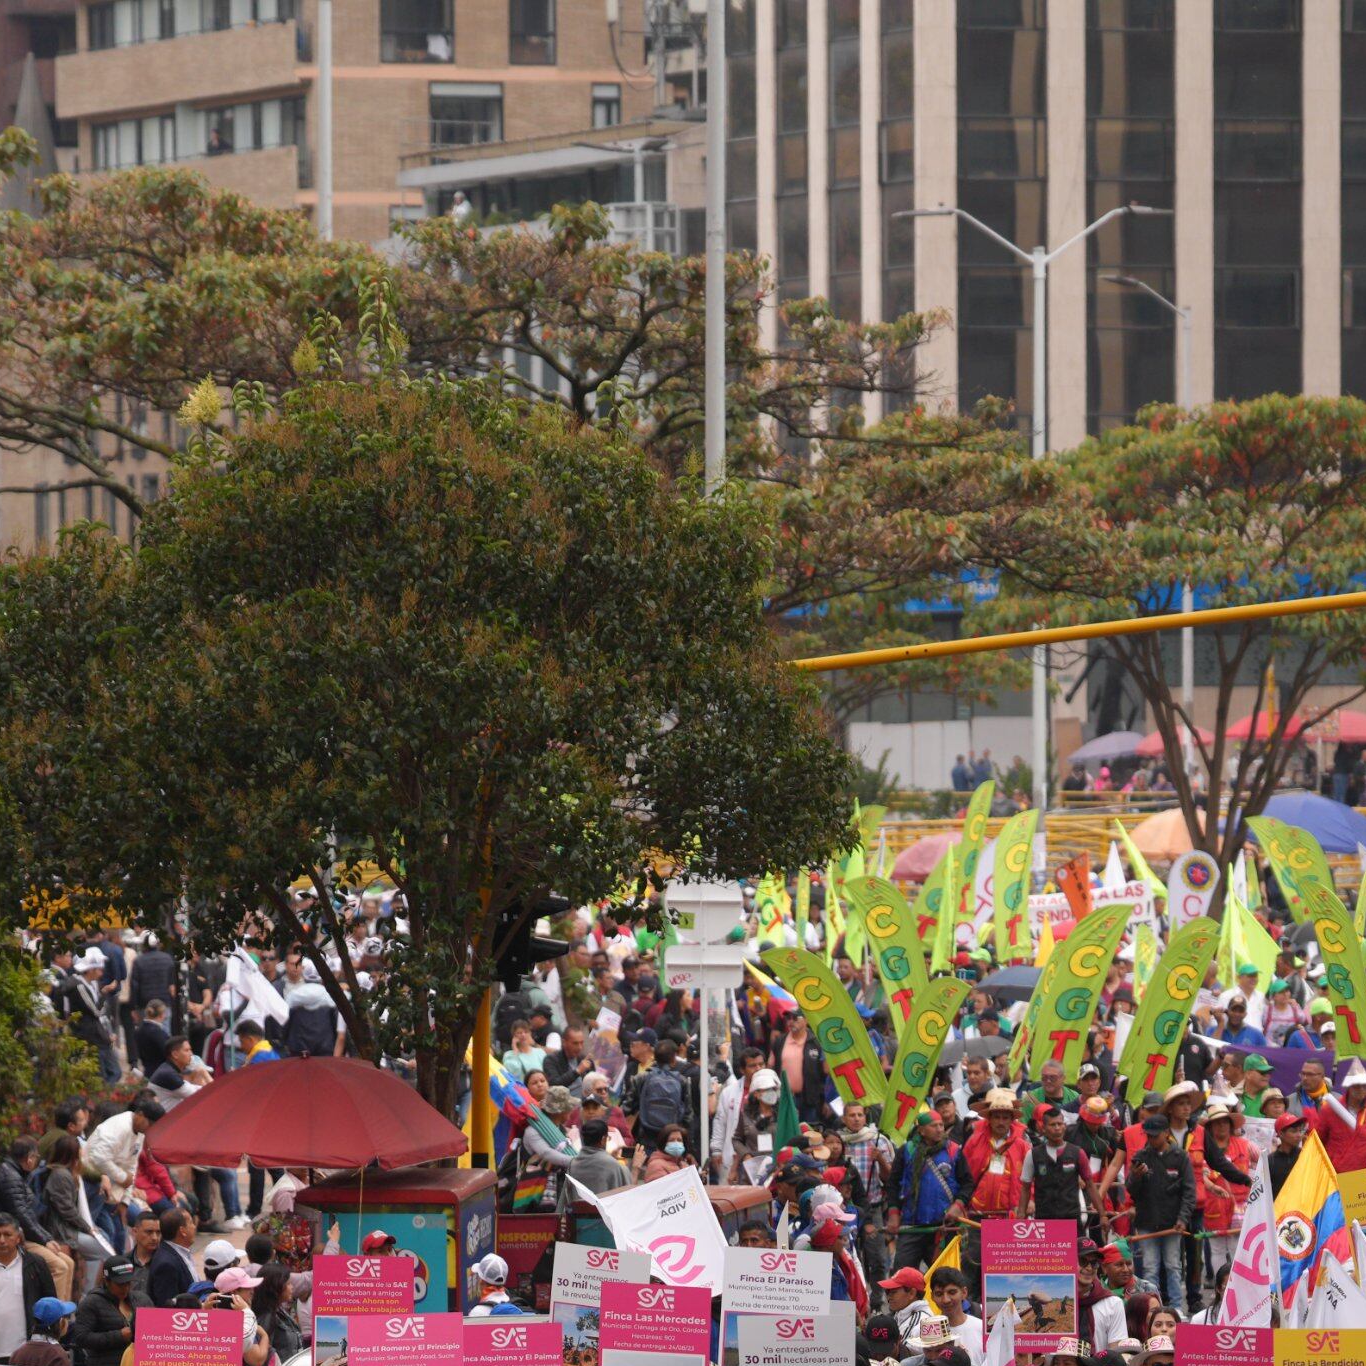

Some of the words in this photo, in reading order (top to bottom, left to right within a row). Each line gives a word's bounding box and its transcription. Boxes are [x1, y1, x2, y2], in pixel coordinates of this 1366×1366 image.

[1013, 1222, 1045, 1238] SAE
[587, 1250, 619, 1270] SAE
[760, 1252, 797, 1272] SAE
[346, 1259, 381, 1277] SAE
[557, 1278, 569, 1287] 30
[572, 1279, 588, 1290] mil
[740, 1274, 765, 1283] Finca
[780, 1276, 814, 1286] Paraíso
[332, 1289, 371, 1297] entregaban
[728, 1284, 762, 1293] Municipio:
[778, 1286, 803, 1295] Marcos,
[637, 1288, 675, 1309] SAE
[752, 1293, 788, 1302] Hectáreas:
[172, 1311, 209, 1331] SAE
[604, 1311, 632, 1321] Finca
[635, 1313, 653, 1322] Las
[656, 1314, 706, 1325] Mercedes
[385, 1317, 425, 1338] SAE
[776, 1318, 814, 1339] SAE
[491, 1327, 527, 1348] SAE
[1215, 1329, 1257, 1350] SAE
[1306, 1331, 1339, 1353] SAE
[427, 1343, 460, 1351] Principio
[776, 1346, 829, 1355] entregamos
[480, 1354, 517, 1363] Alquitrana
[745, 1355, 760, 1364] 30
[762, 1354, 781, 1364] mil
[784, 1355, 827, 1364] hectáreas
[829, 1357, 849, 1365] para
[1182, 1353, 1204, 1361] Antes
[1219, 1354, 1248, 1362] bienes
[1308, 1359, 1318, 1366] La
[1320, 1358, 1365, 1366] Bendición
